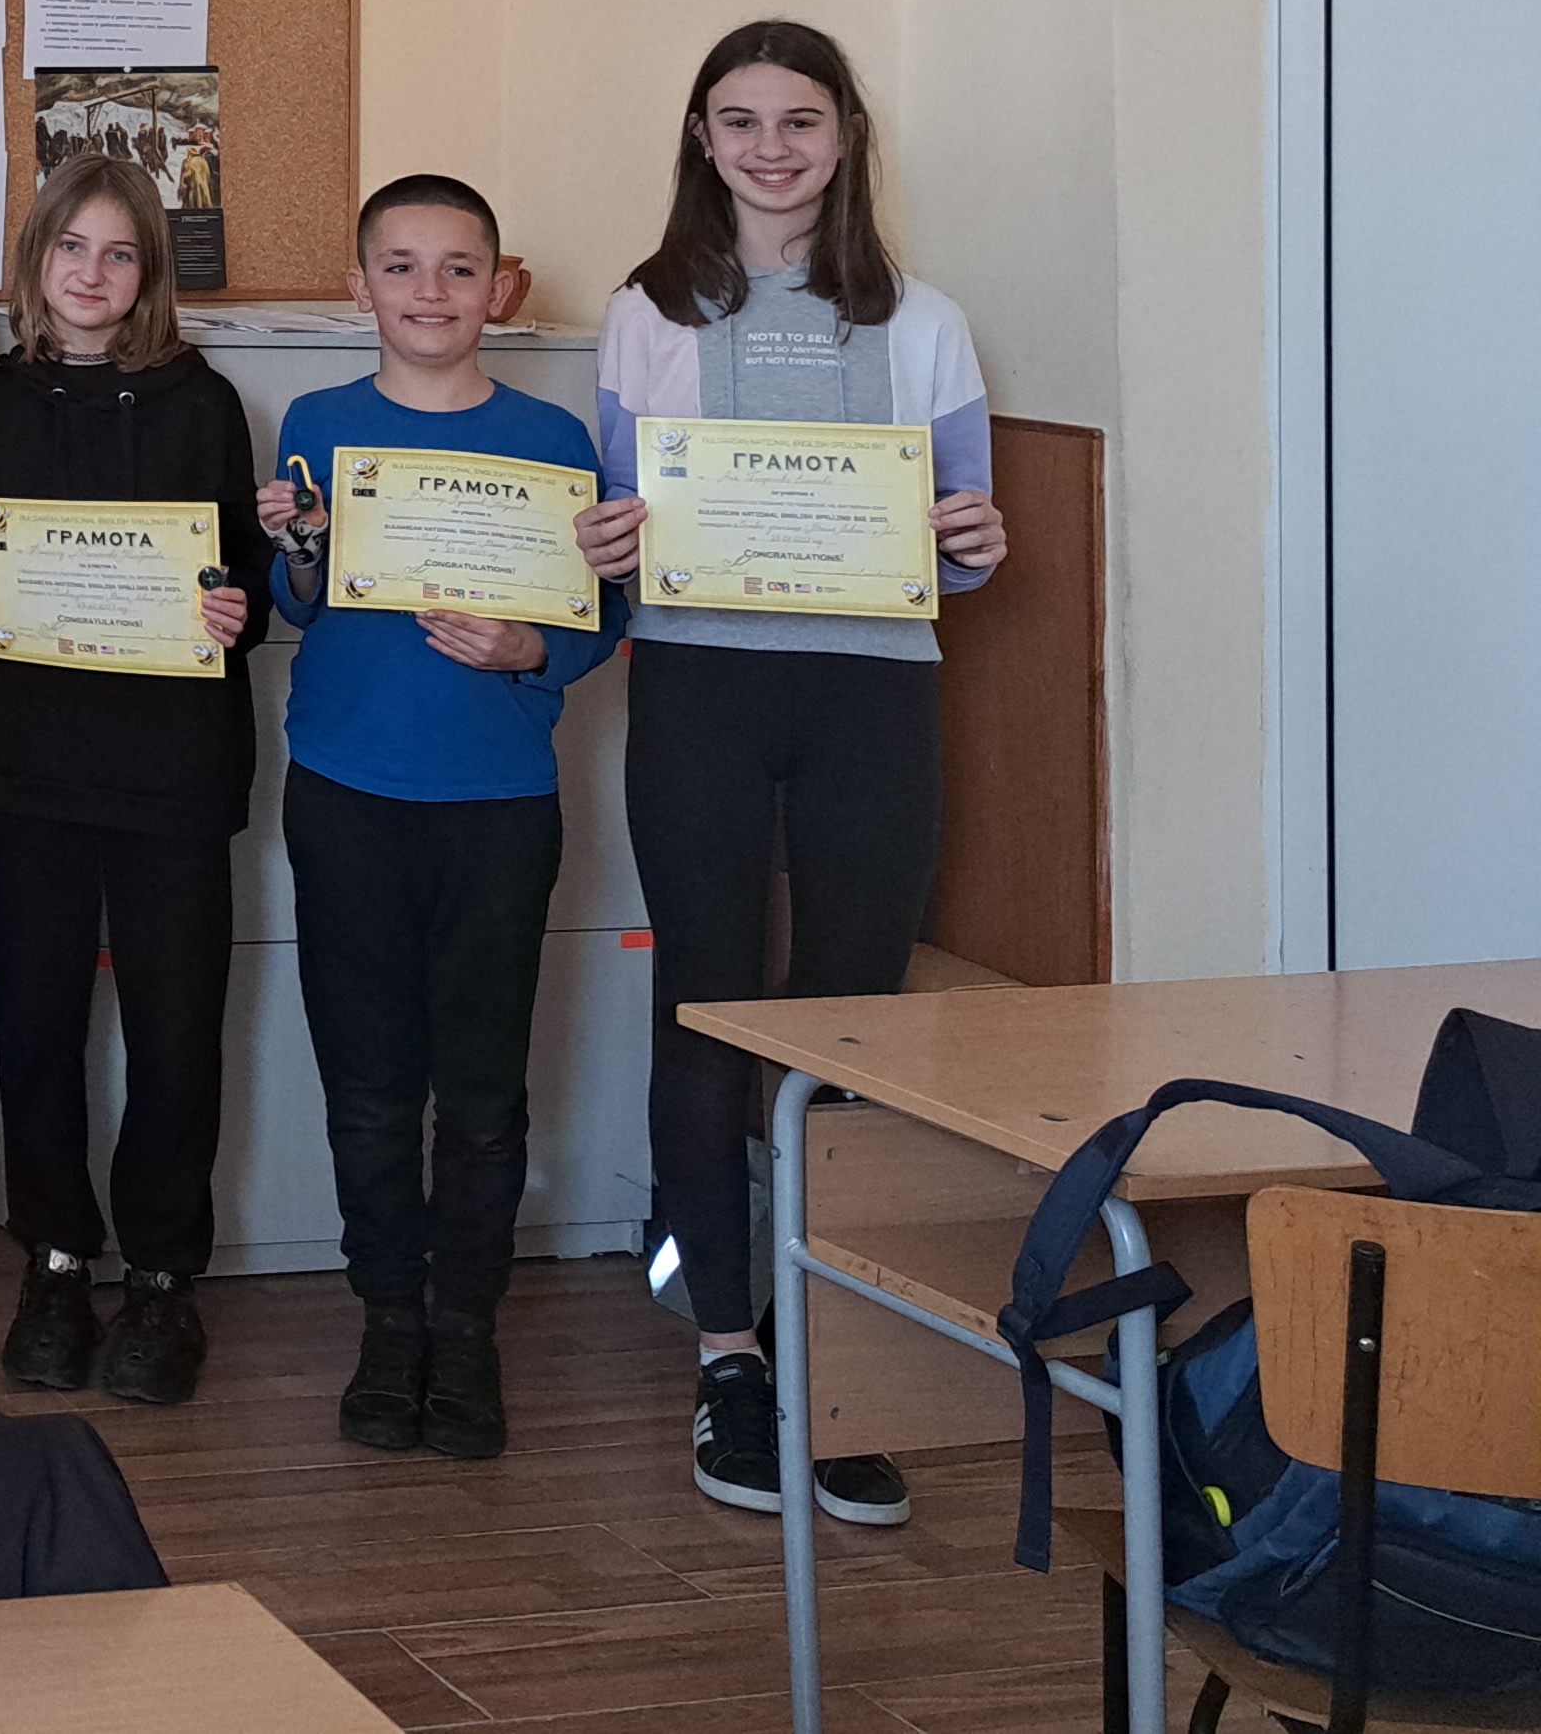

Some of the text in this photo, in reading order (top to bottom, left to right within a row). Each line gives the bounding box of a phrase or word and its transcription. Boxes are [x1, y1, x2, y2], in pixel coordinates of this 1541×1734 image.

[747, 333, 782, 341] NOTE
[786, 334, 804, 342] TO
[733, 452, 857, 473] ГРАМОТА
[418, 476, 530, 501] ГРАМОТА
[46, 529, 154, 547] ГРАМОТА
[424, 559, 516, 575] CONGRATULATIONS!
